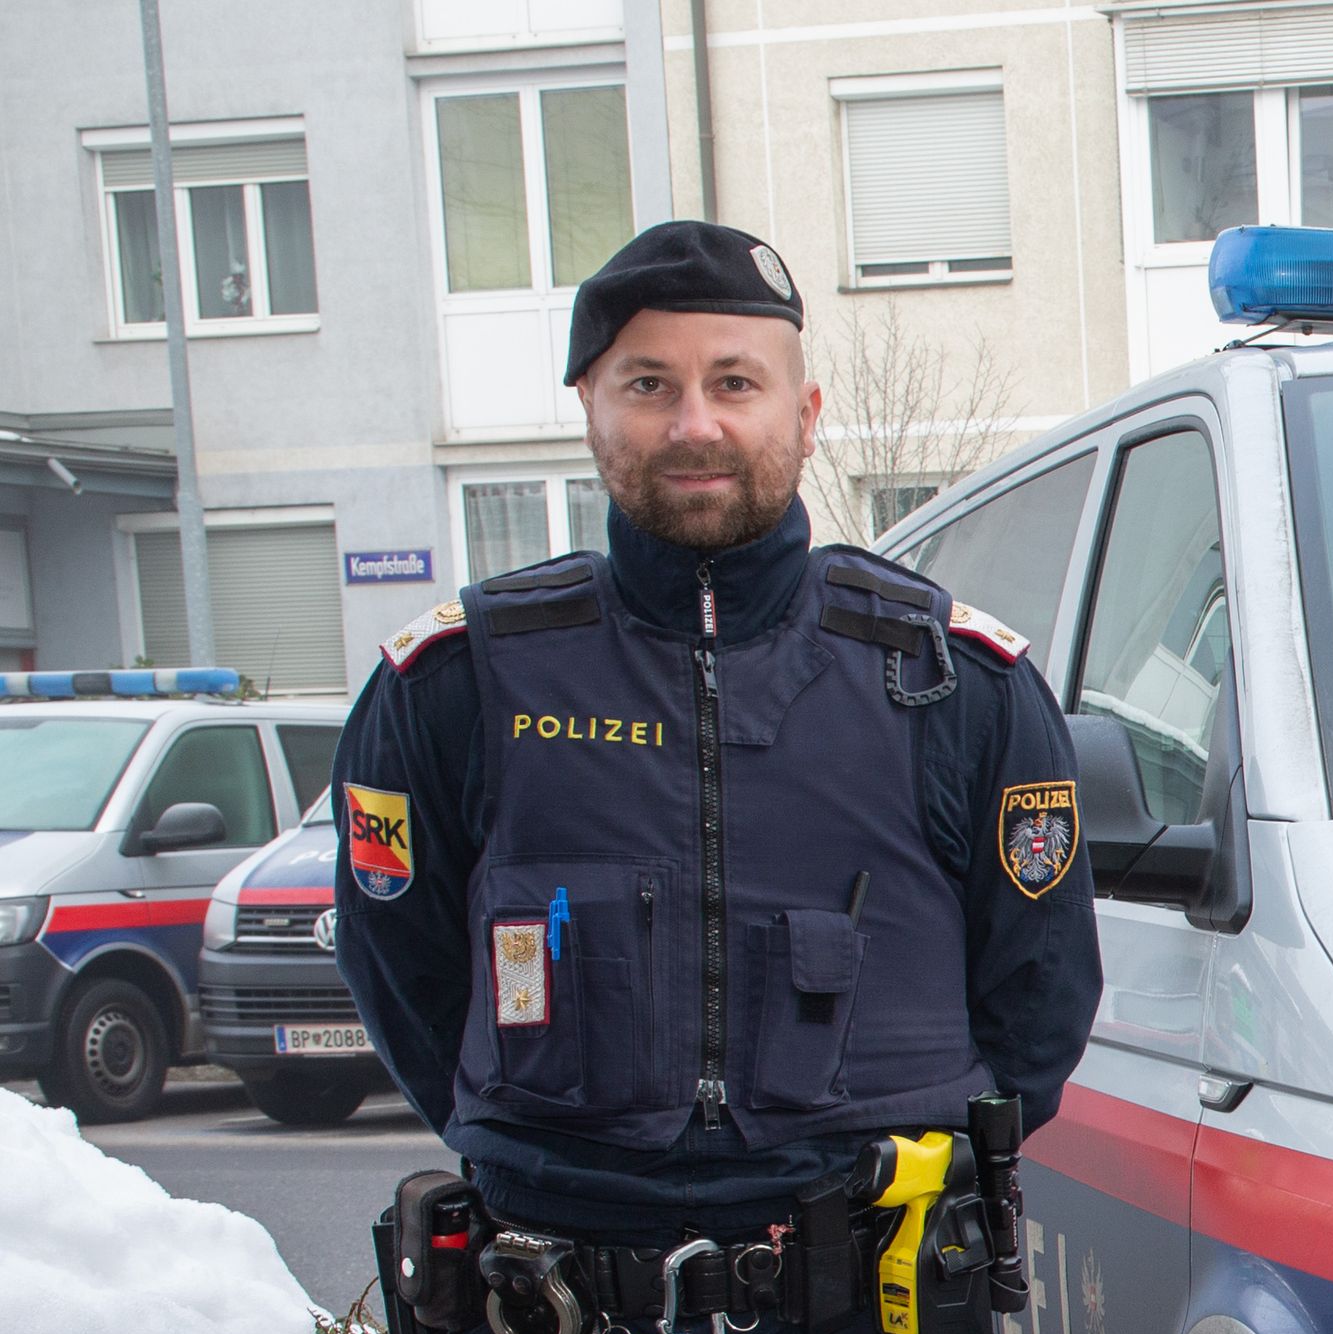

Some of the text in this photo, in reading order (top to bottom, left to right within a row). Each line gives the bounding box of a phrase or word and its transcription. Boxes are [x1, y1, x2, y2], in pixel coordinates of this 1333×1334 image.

[350, 553, 425, 579] Kempfstraße
[703, 594, 714, 633] POLIZEI
[513, 714, 663, 746] POLIZEI
[351, 809, 408, 850] SRK
[291, 1029, 367, 1048] BP 2088
